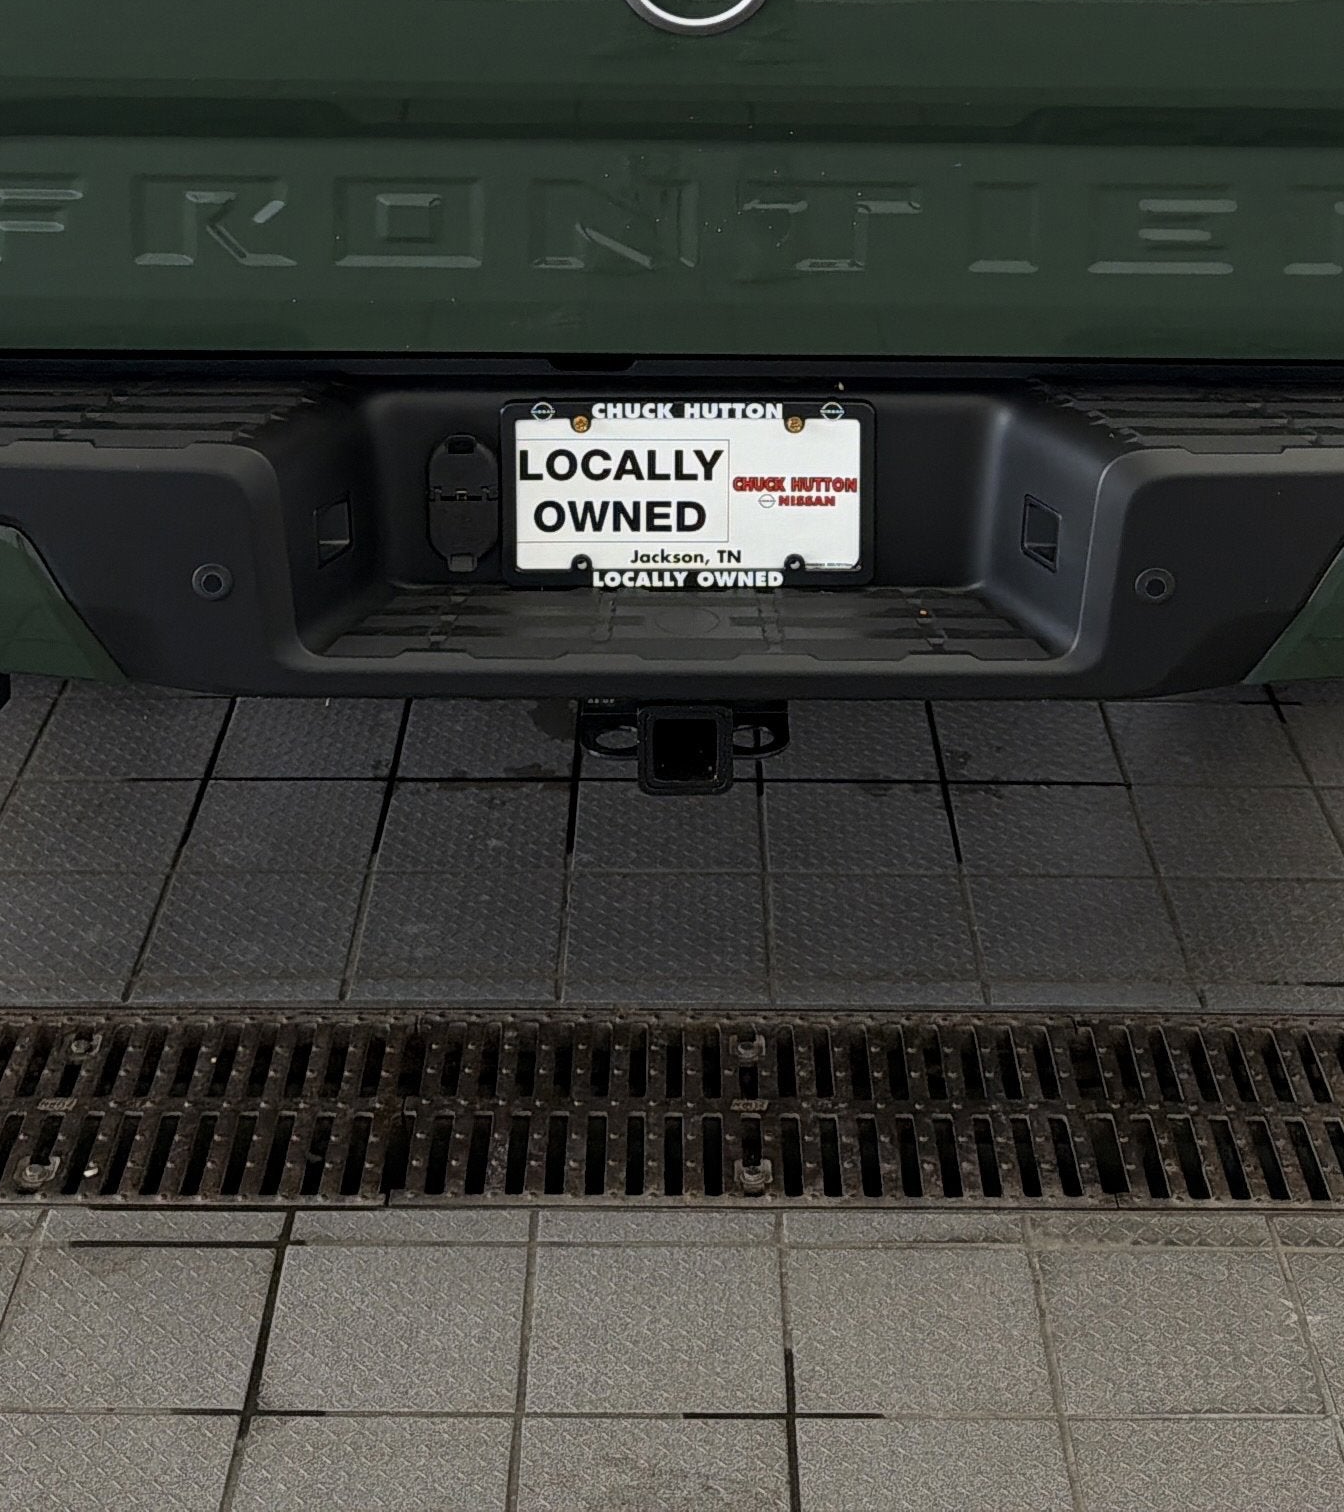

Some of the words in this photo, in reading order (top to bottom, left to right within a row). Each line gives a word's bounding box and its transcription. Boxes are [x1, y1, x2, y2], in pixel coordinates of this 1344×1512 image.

[591, 403, 673, 420] CHUCK
[684, 403, 784, 420] HUTTON
[519, 449, 725, 481] LOCALLY
[733, 476, 786, 492] CHUCK
[791, 476, 858, 493] HUTTON
[778, 495, 836, 506] NISSAN
[533, 500, 707, 533] OWNED
[630, 548, 710, 565] Jackson,
[717, 549, 742, 564] TN
[592, 571, 690, 588] LOCALLY
[697, 571, 784, 588] OWNED
